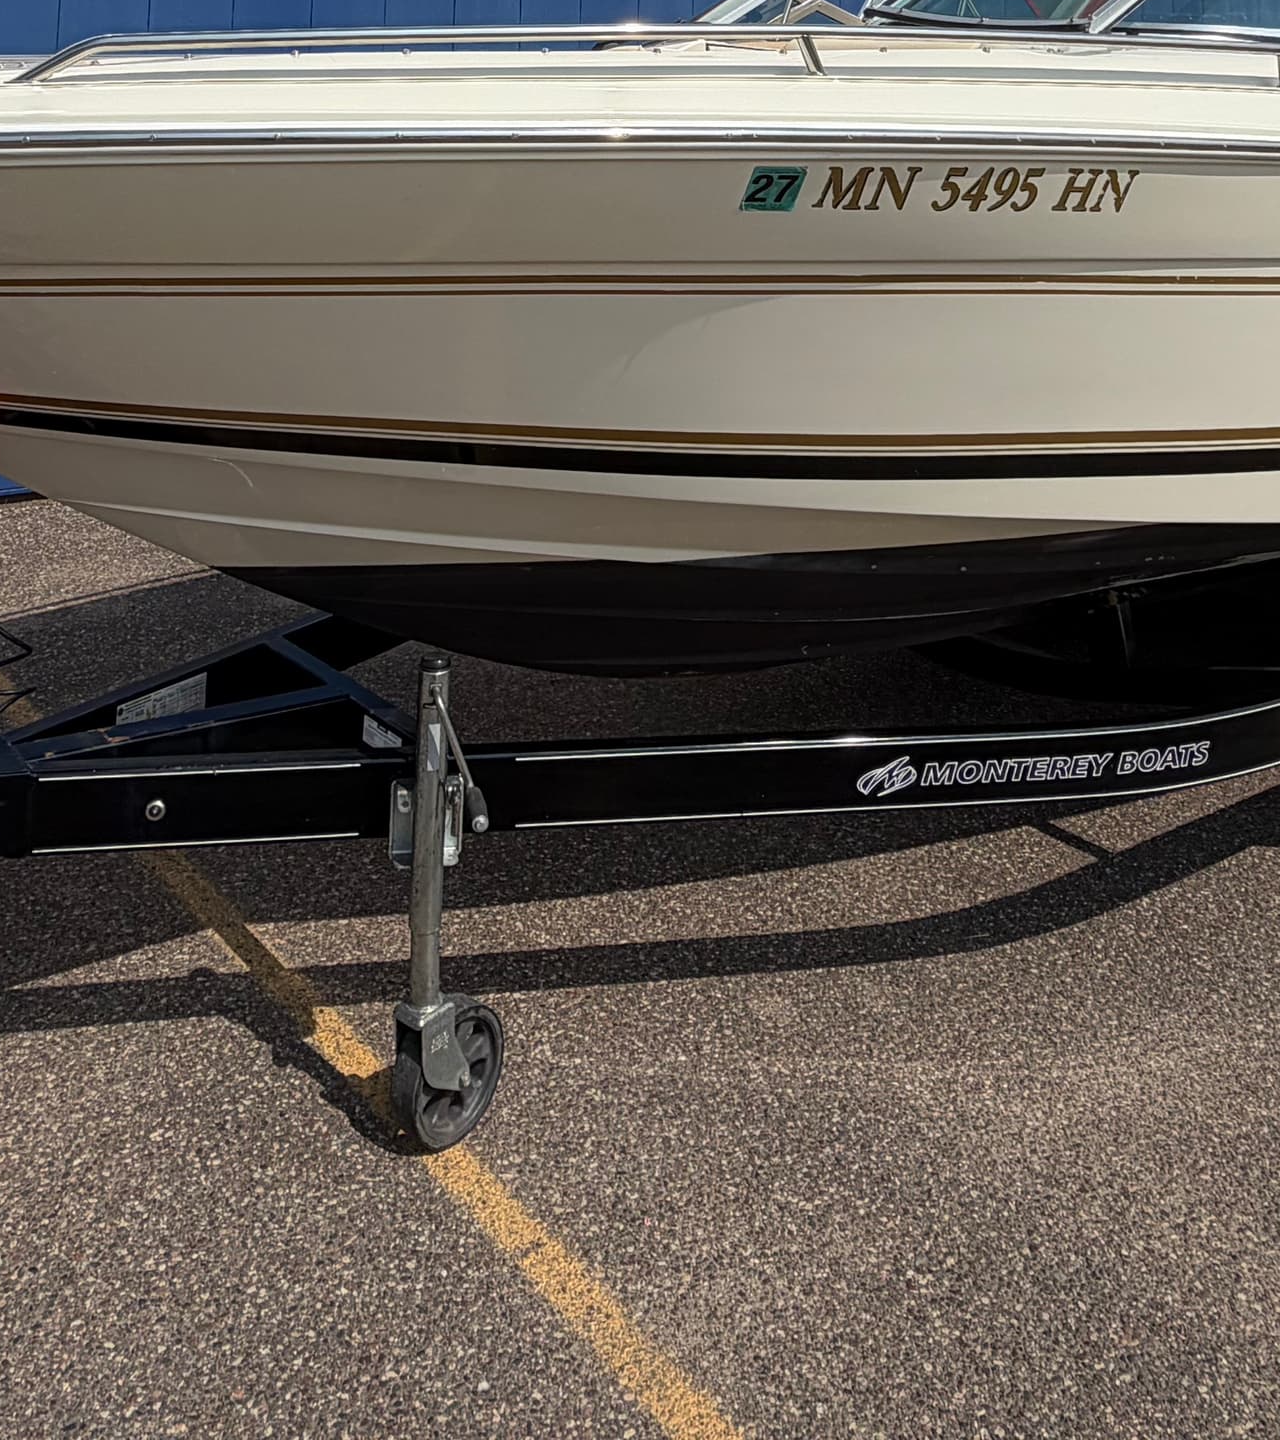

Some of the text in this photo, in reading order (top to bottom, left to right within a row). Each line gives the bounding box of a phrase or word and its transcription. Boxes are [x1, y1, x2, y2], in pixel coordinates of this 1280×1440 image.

[744, 173, 800, 204] 27
[811, 165, 1141, 213] MN 5495 HN
[919, 740, 1212, 787] MONTEREY BOATS
